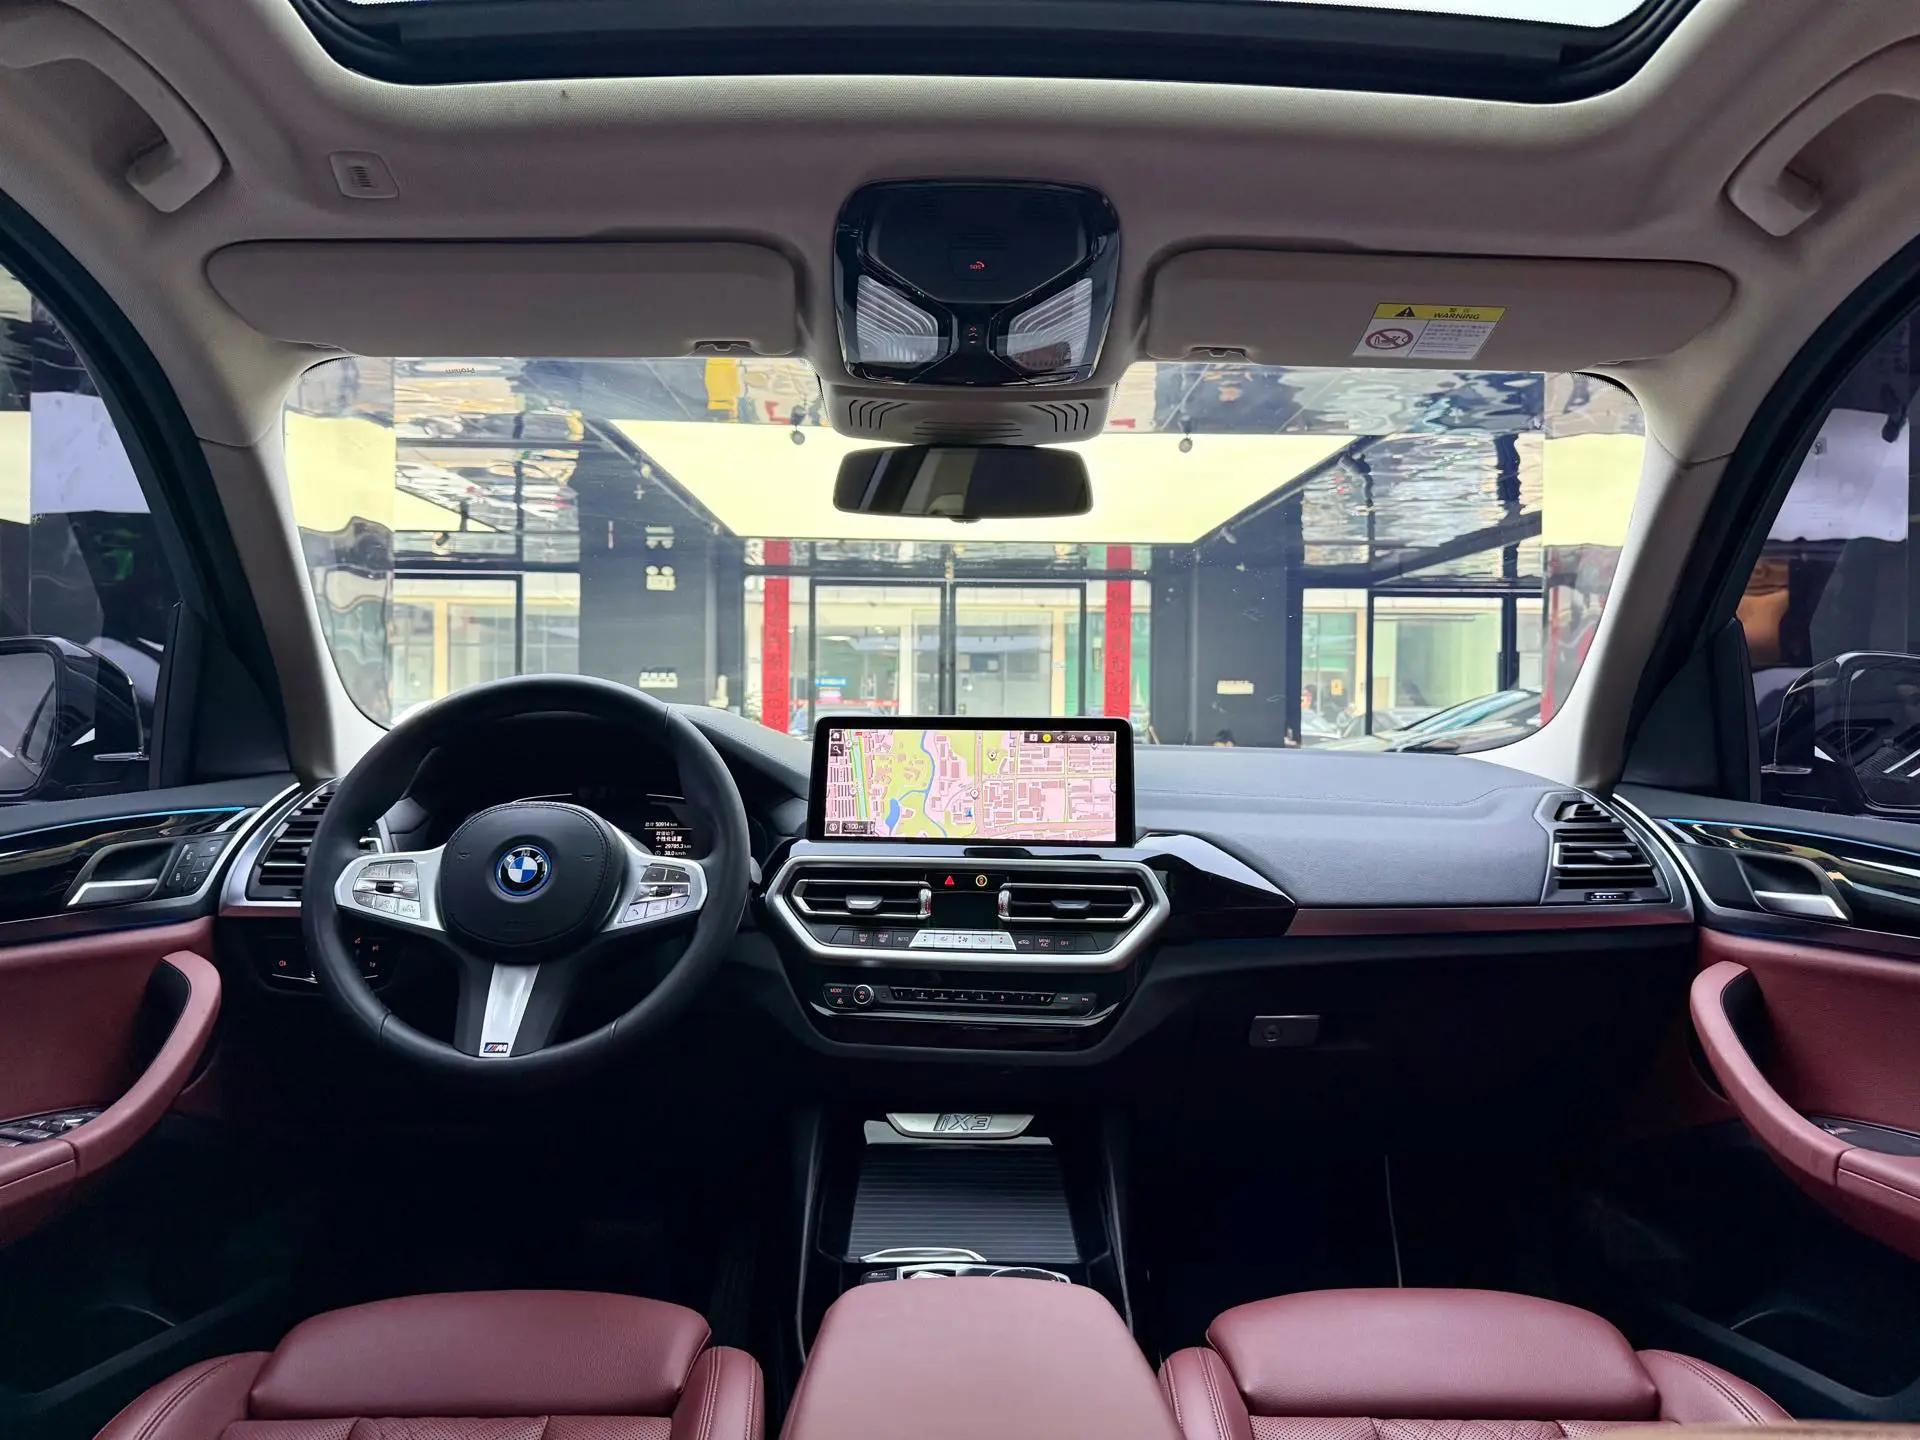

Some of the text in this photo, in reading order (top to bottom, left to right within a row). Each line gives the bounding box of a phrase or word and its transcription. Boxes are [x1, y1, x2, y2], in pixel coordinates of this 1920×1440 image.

[1433, 312, 1481, 320] WARNING
[505, 849, 544, 863] BMW
[933, 1112, 993, 1131] iX3
